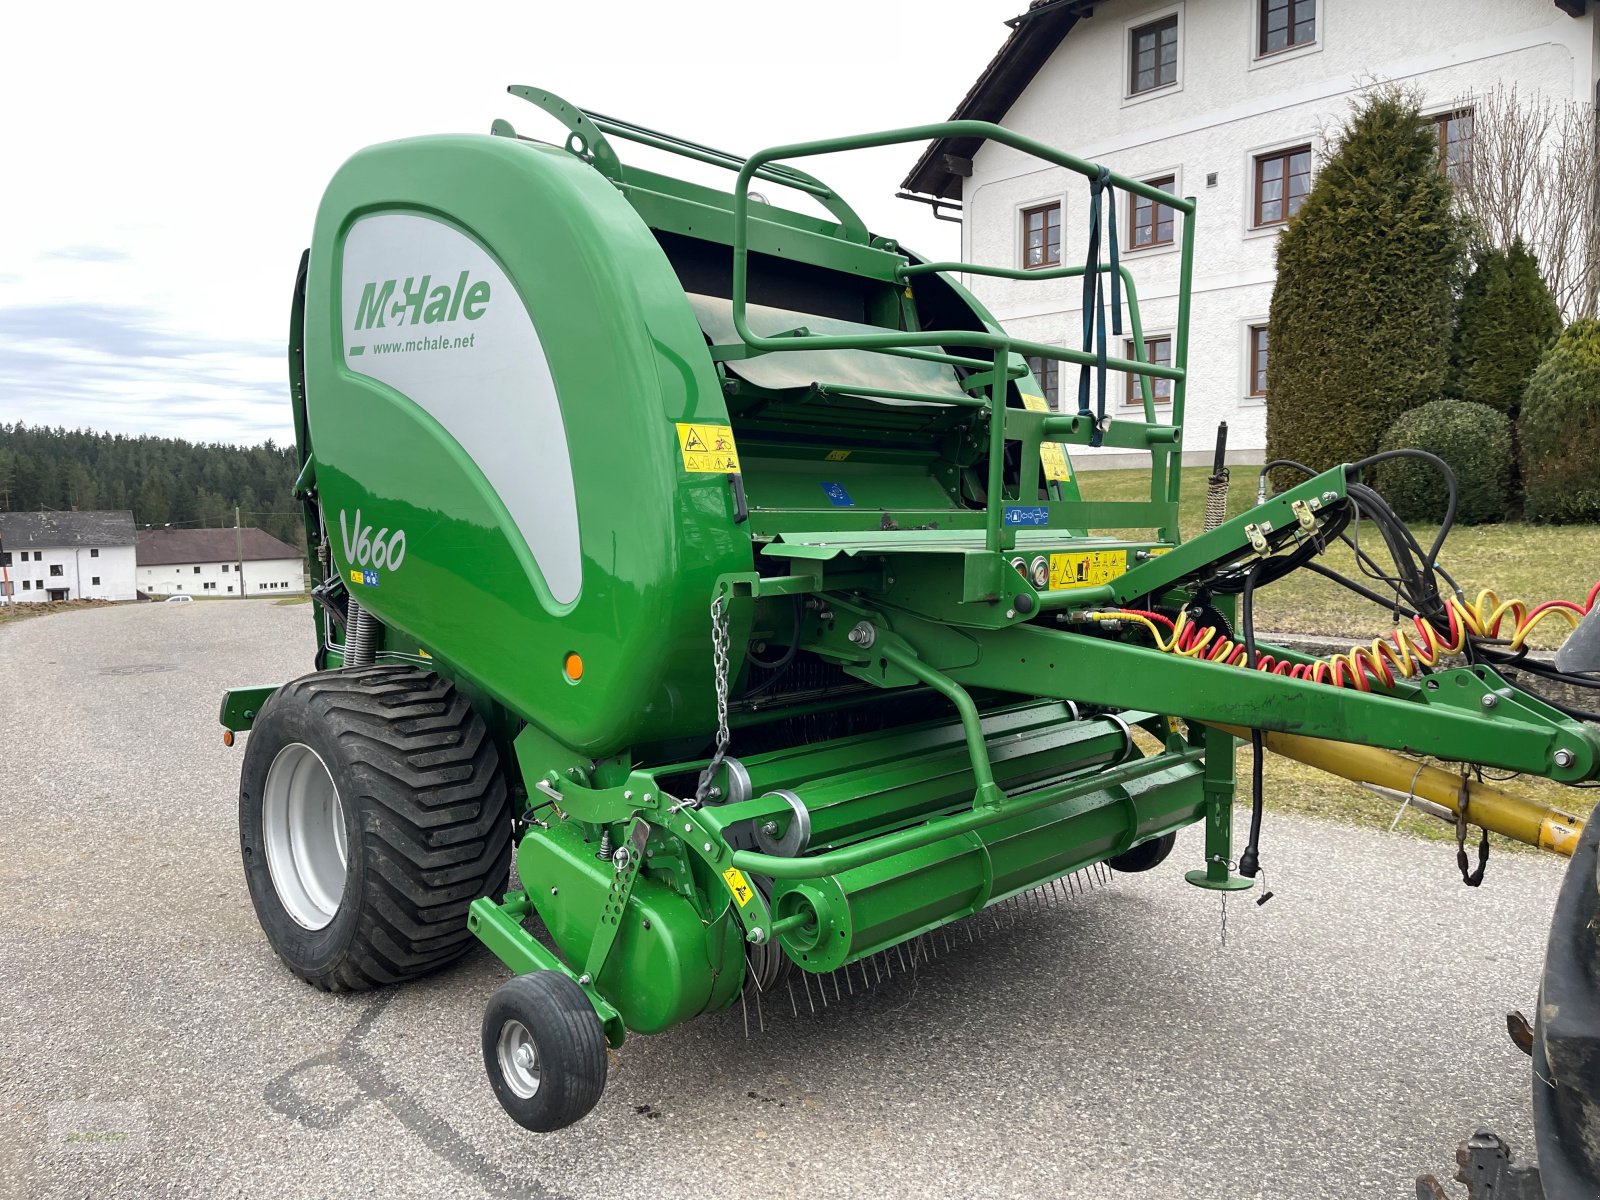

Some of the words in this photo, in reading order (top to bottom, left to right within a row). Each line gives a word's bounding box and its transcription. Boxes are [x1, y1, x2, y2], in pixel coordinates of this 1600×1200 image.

[353, 270, 491, 331] McHale
[373, 333, 475, 355] www.mchale.net
[339, 508, 406, 572] V660
